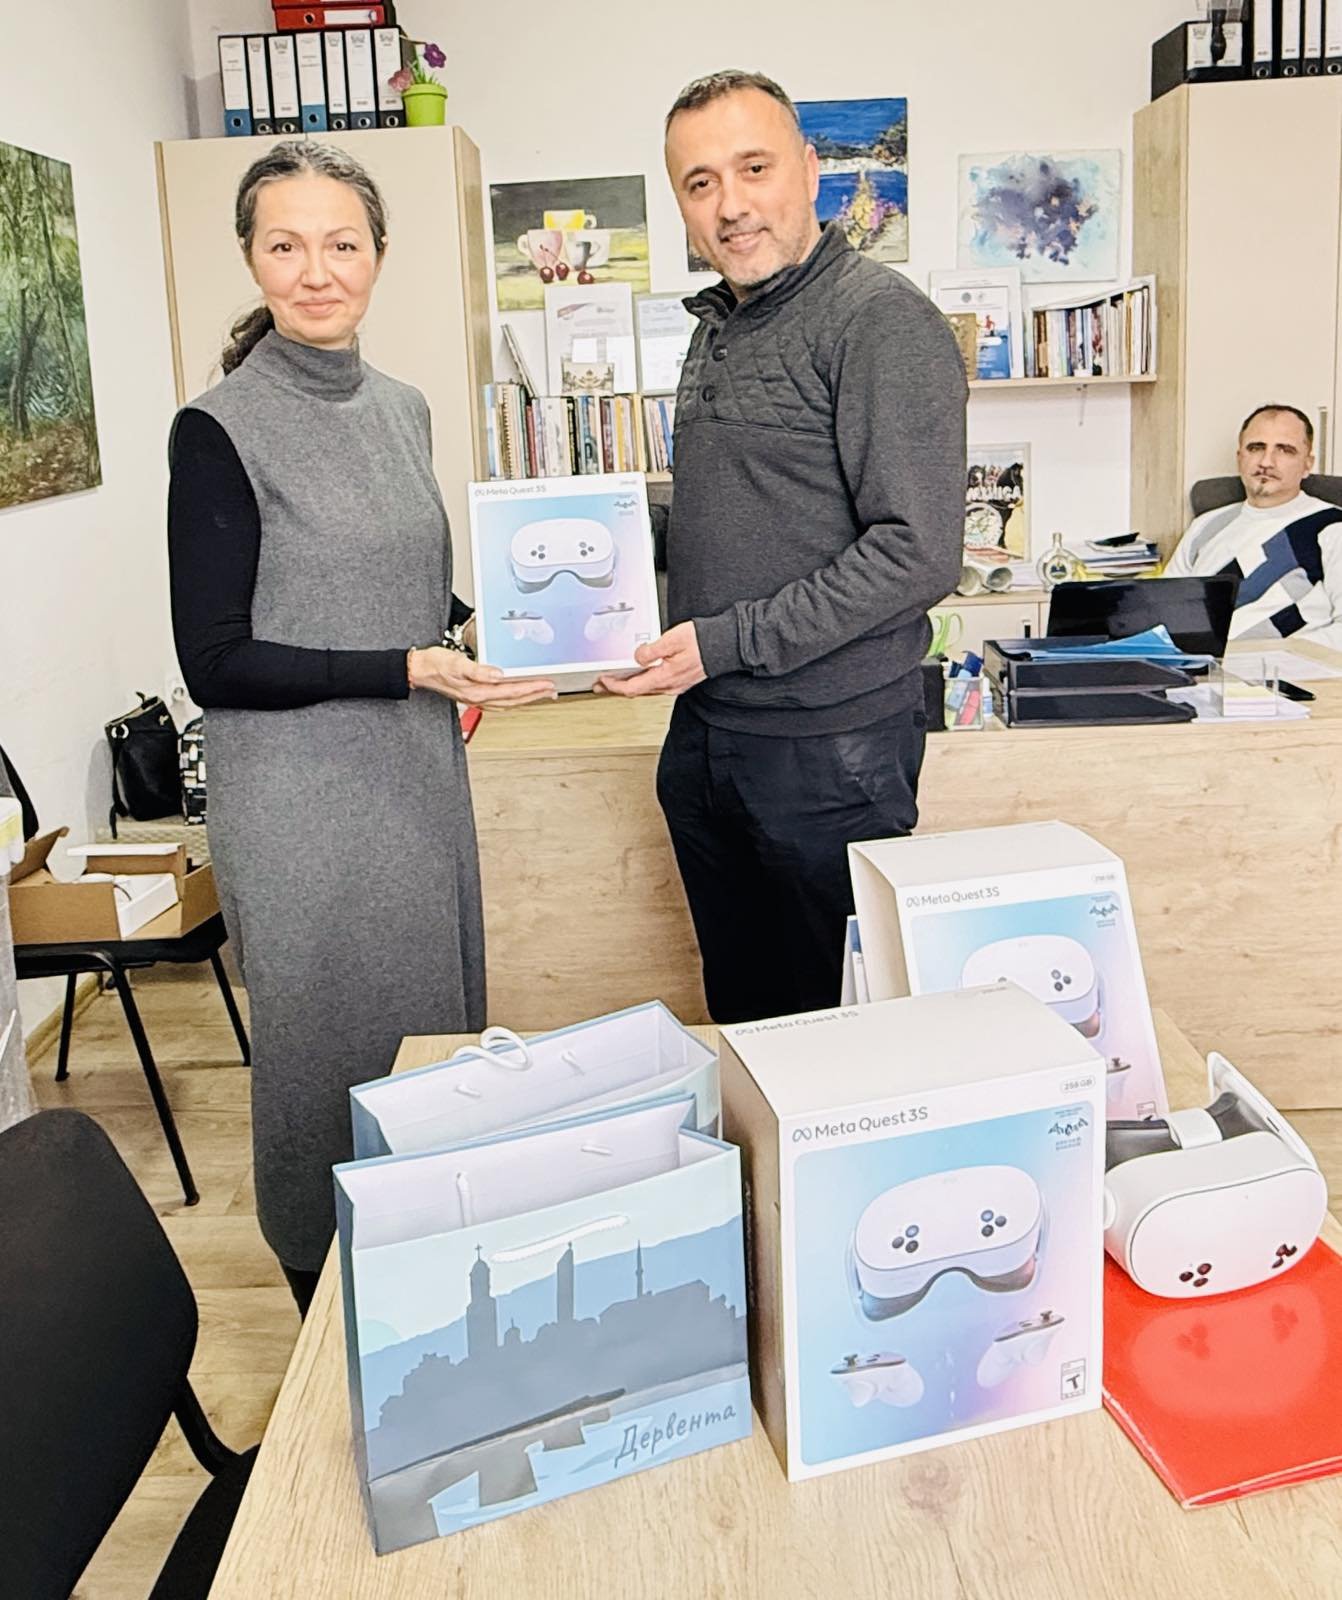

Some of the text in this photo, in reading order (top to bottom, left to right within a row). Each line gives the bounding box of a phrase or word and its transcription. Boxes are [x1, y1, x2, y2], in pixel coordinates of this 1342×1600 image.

[921, 886, 1000, 905] Meta Quest 3S
[755, 1022, 794, 1033] Meta
[795, 1014, 839, 1026] Quest
[815, 1105, 928, 1139] Meta Quest 3S
[1066, 1373, 1080, 1390] T
[613, 1404, 737, 1469] Дервента
